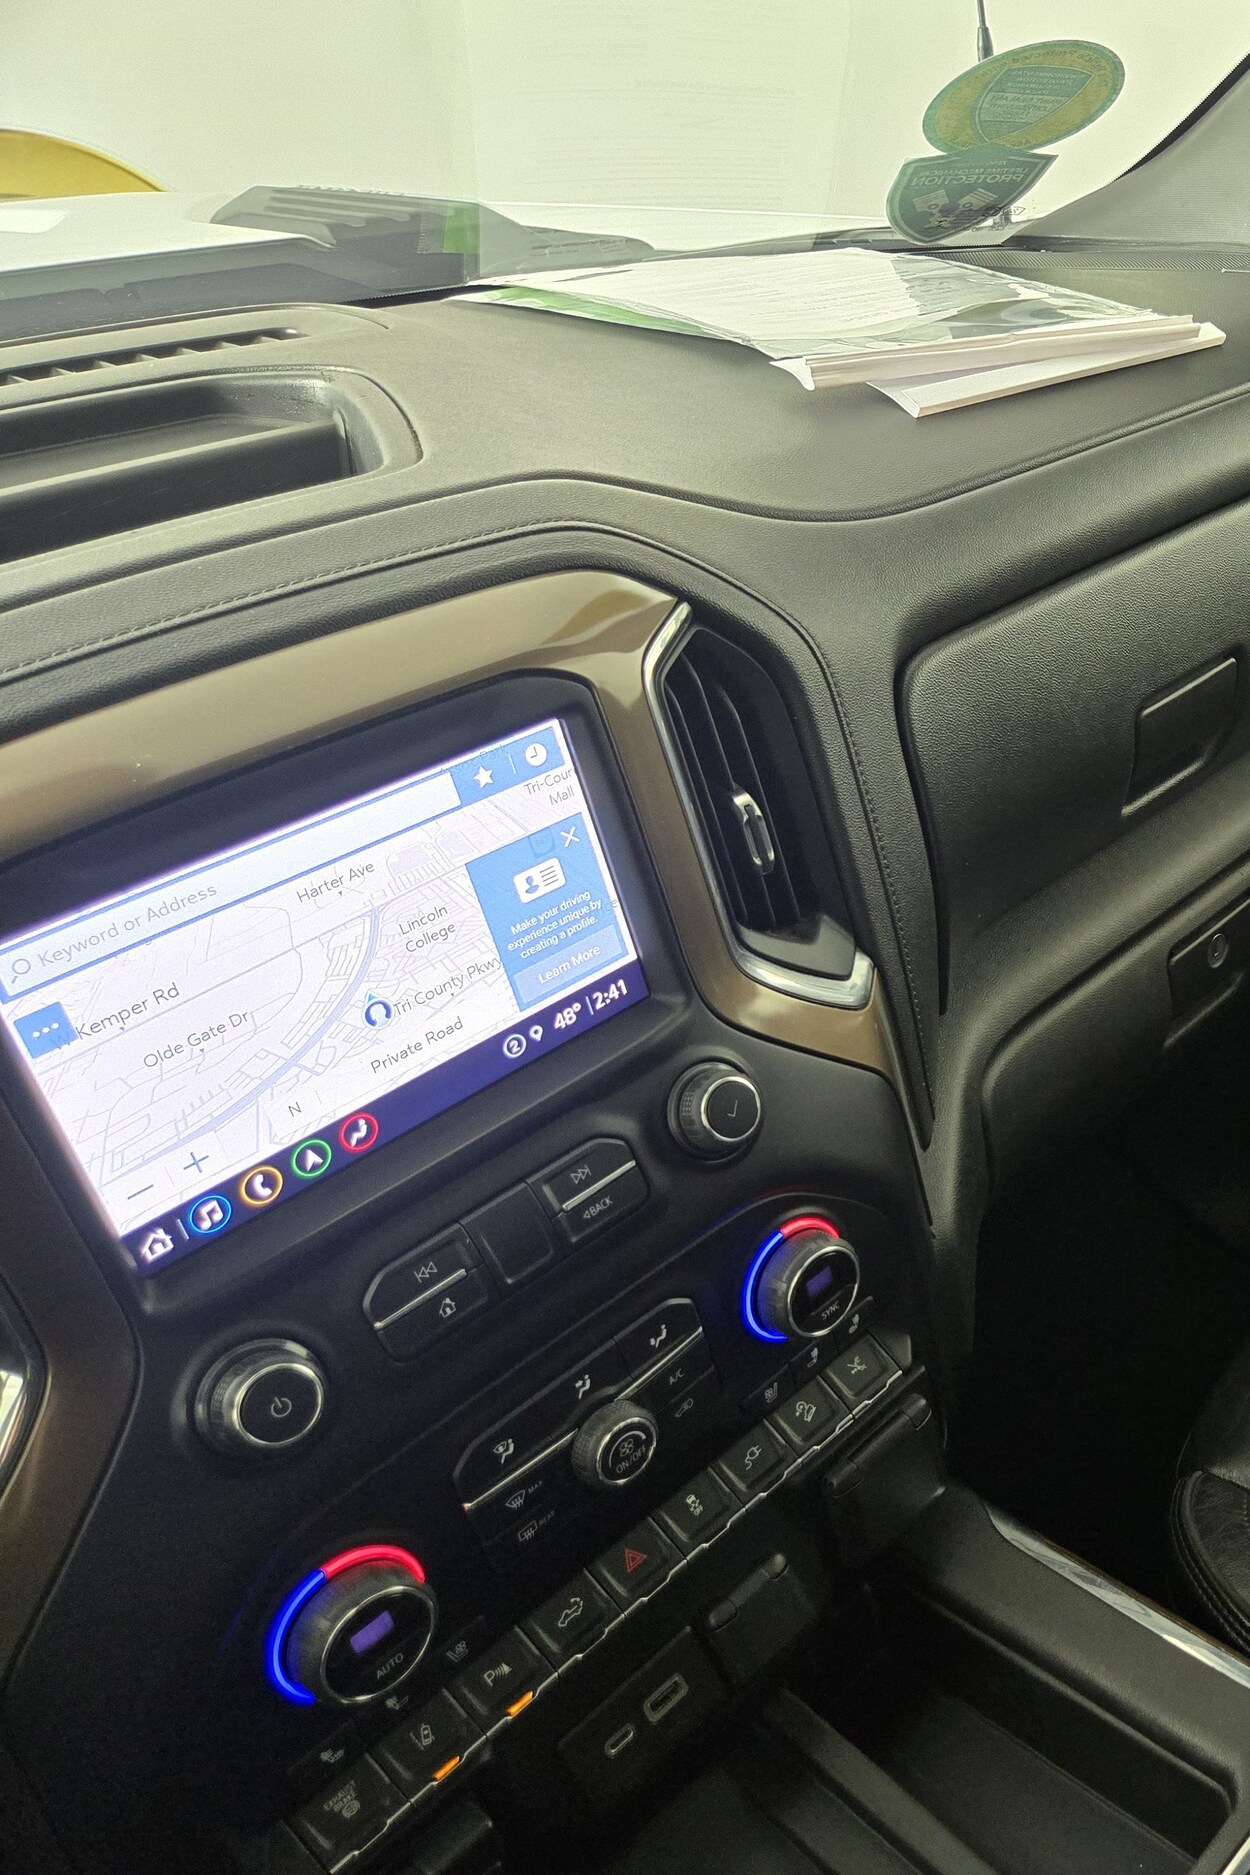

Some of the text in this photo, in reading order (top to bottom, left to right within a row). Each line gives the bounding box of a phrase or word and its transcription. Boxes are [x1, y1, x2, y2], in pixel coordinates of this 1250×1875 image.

[549, 785, 575, 806] Mall
[296, 862, 375, 903] Harter Ave
[38, 885, 218, 966] Keyword or Address
[399, 905, 449, 936] Lincoln
[507, 920, 559, 951] experience
[559, 905, 590, 926] unique
[590, 898, 602, 911] by
[510, 917, 538, 936] Make
[538, 905, 560, 924] your
[560, 890, 592, 911] driving
[404, 922, 457, 954] College
[520, 914, 599, 959] creating a profile.
[538, 946, 601, 985] Learn More
[393, 957, 503, 1016] Tri County Pkwy
[592, 979, 628, 1011] 2:41
[76, 999, 149, 1040] Kemper
[152, 981, 181, 1006] Rd
[143, 1012, 249, 1068] Olde Gate Dr
[369, 1016, 464, 1074] Private Road
[589, 1195, 613, 1216] BACK
[821, 1300, 840, 1320] SYNC
[669, 1368, 685, 1386] A/C
[616, 1444, 647, 1474] ON/OFF
[527, 1480, 543, 1494] MAX
[376, 1652, 404, 1680] AUTO
